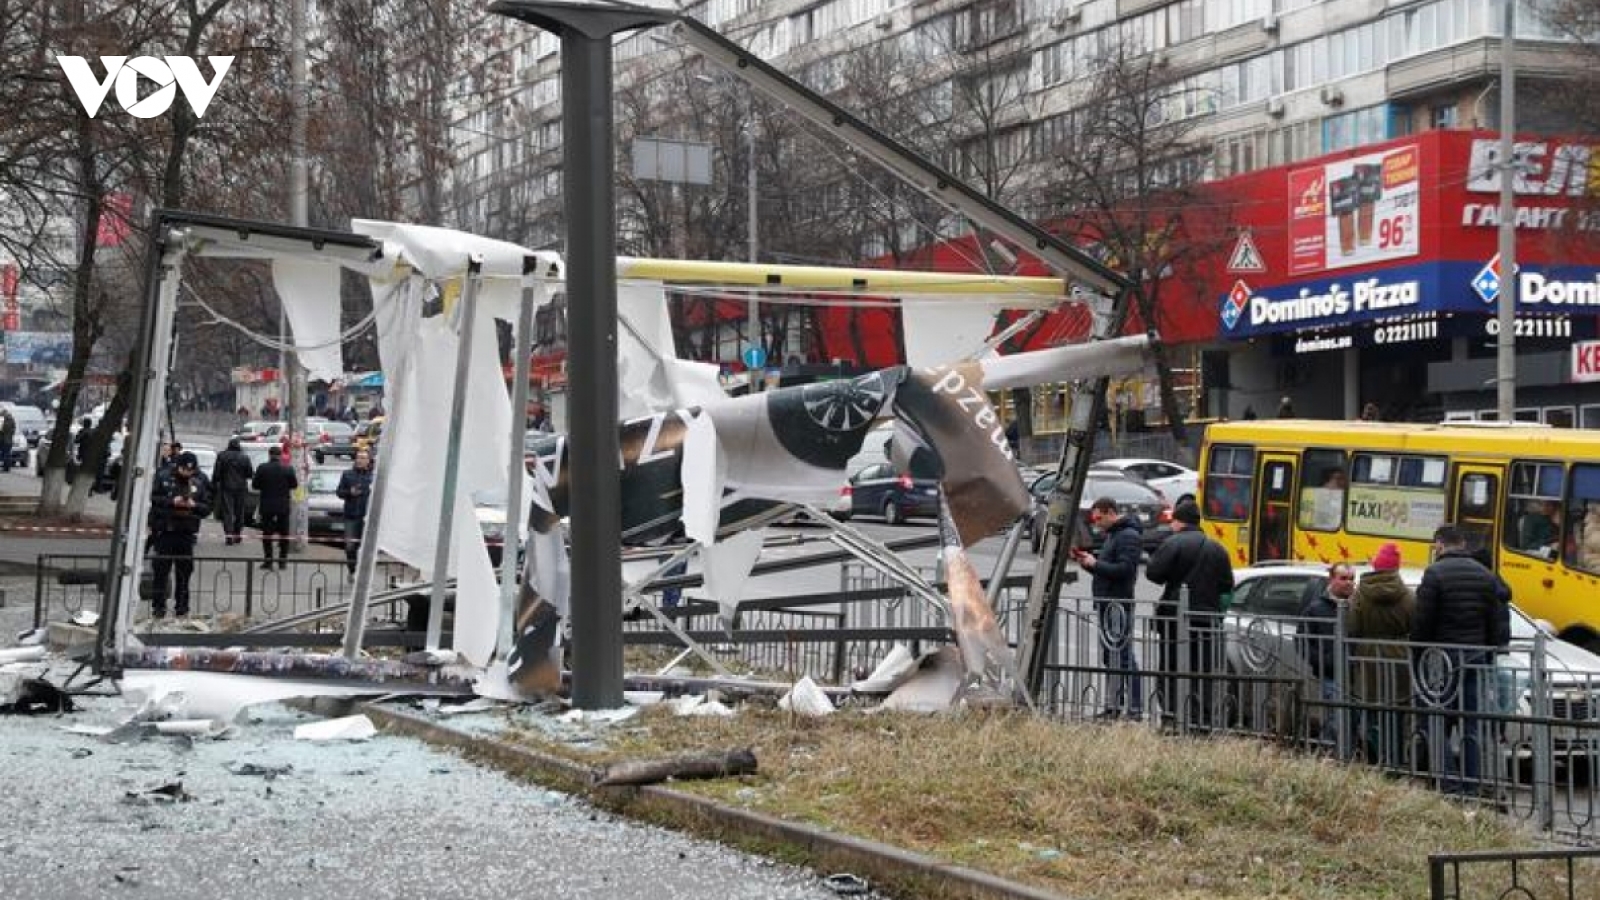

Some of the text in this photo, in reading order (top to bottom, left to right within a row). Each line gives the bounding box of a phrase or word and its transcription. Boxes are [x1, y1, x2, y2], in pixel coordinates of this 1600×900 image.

[1462, 203, 1569, 228] ГААНТ
[1251, 279, 1419, 325] Domino's Pizza
[1512, 318, 1571, 337] 221111
[1349, 499, 1381, 519] TAXI
